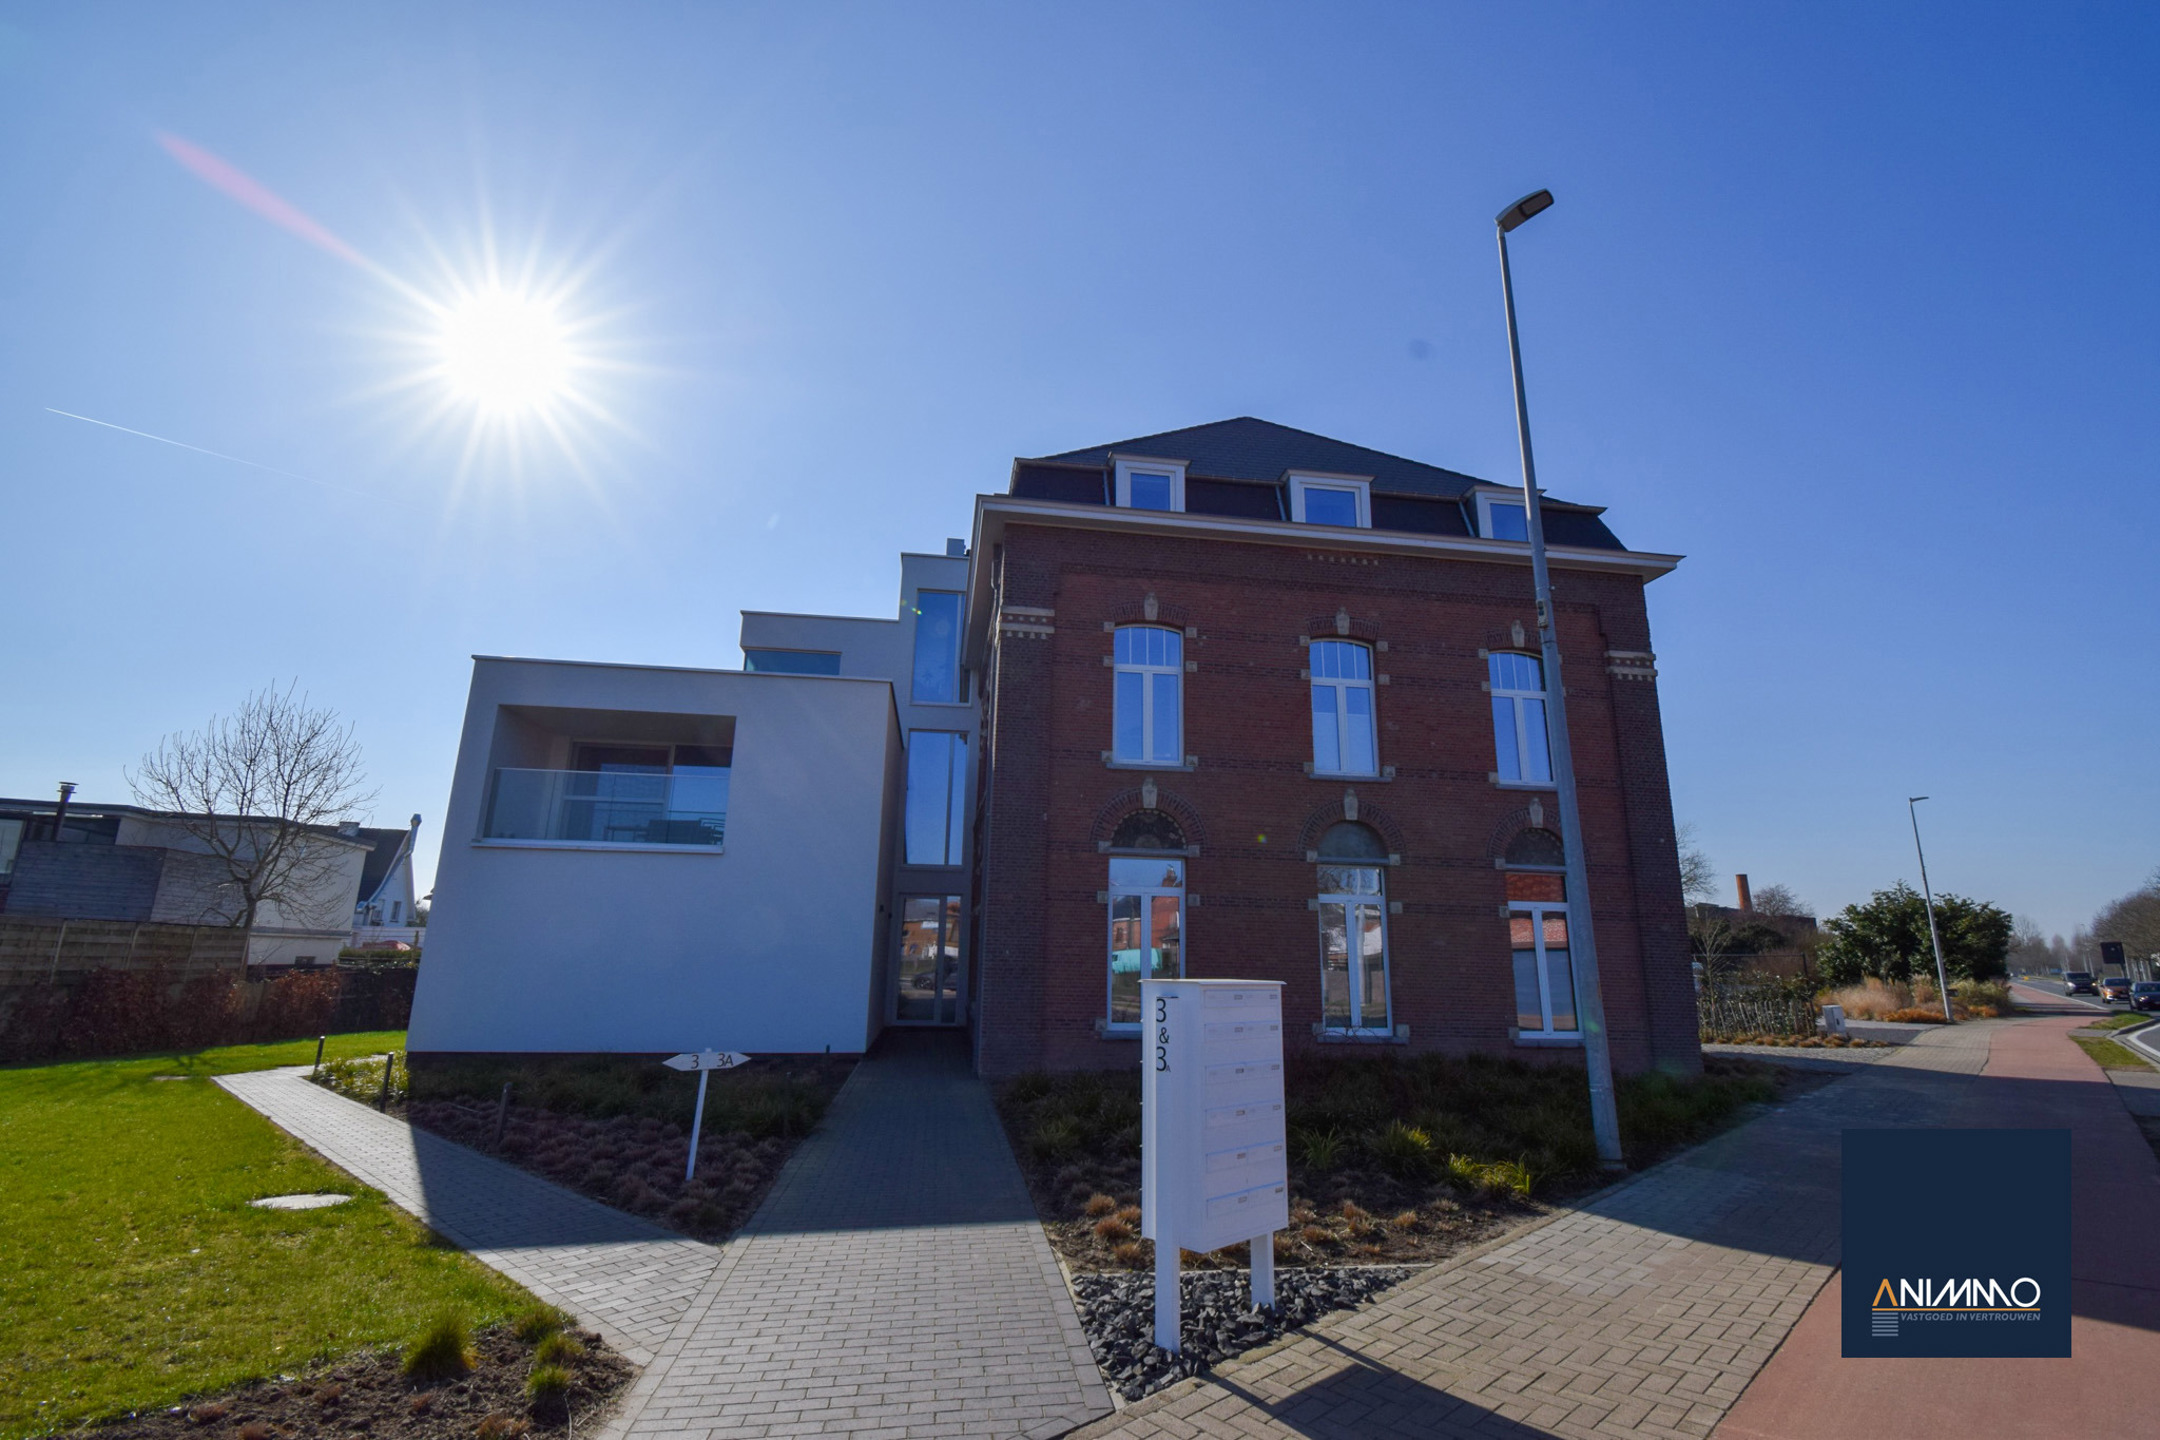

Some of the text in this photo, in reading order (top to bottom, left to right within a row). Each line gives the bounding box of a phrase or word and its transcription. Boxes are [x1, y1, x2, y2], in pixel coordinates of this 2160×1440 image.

[1156, 998, 1166, 1023] 3
[1158, 1026, 1170, 1044] &
[691, 1054, 699, 1069] 3
[717, 1053, 734, 1067] 3A
